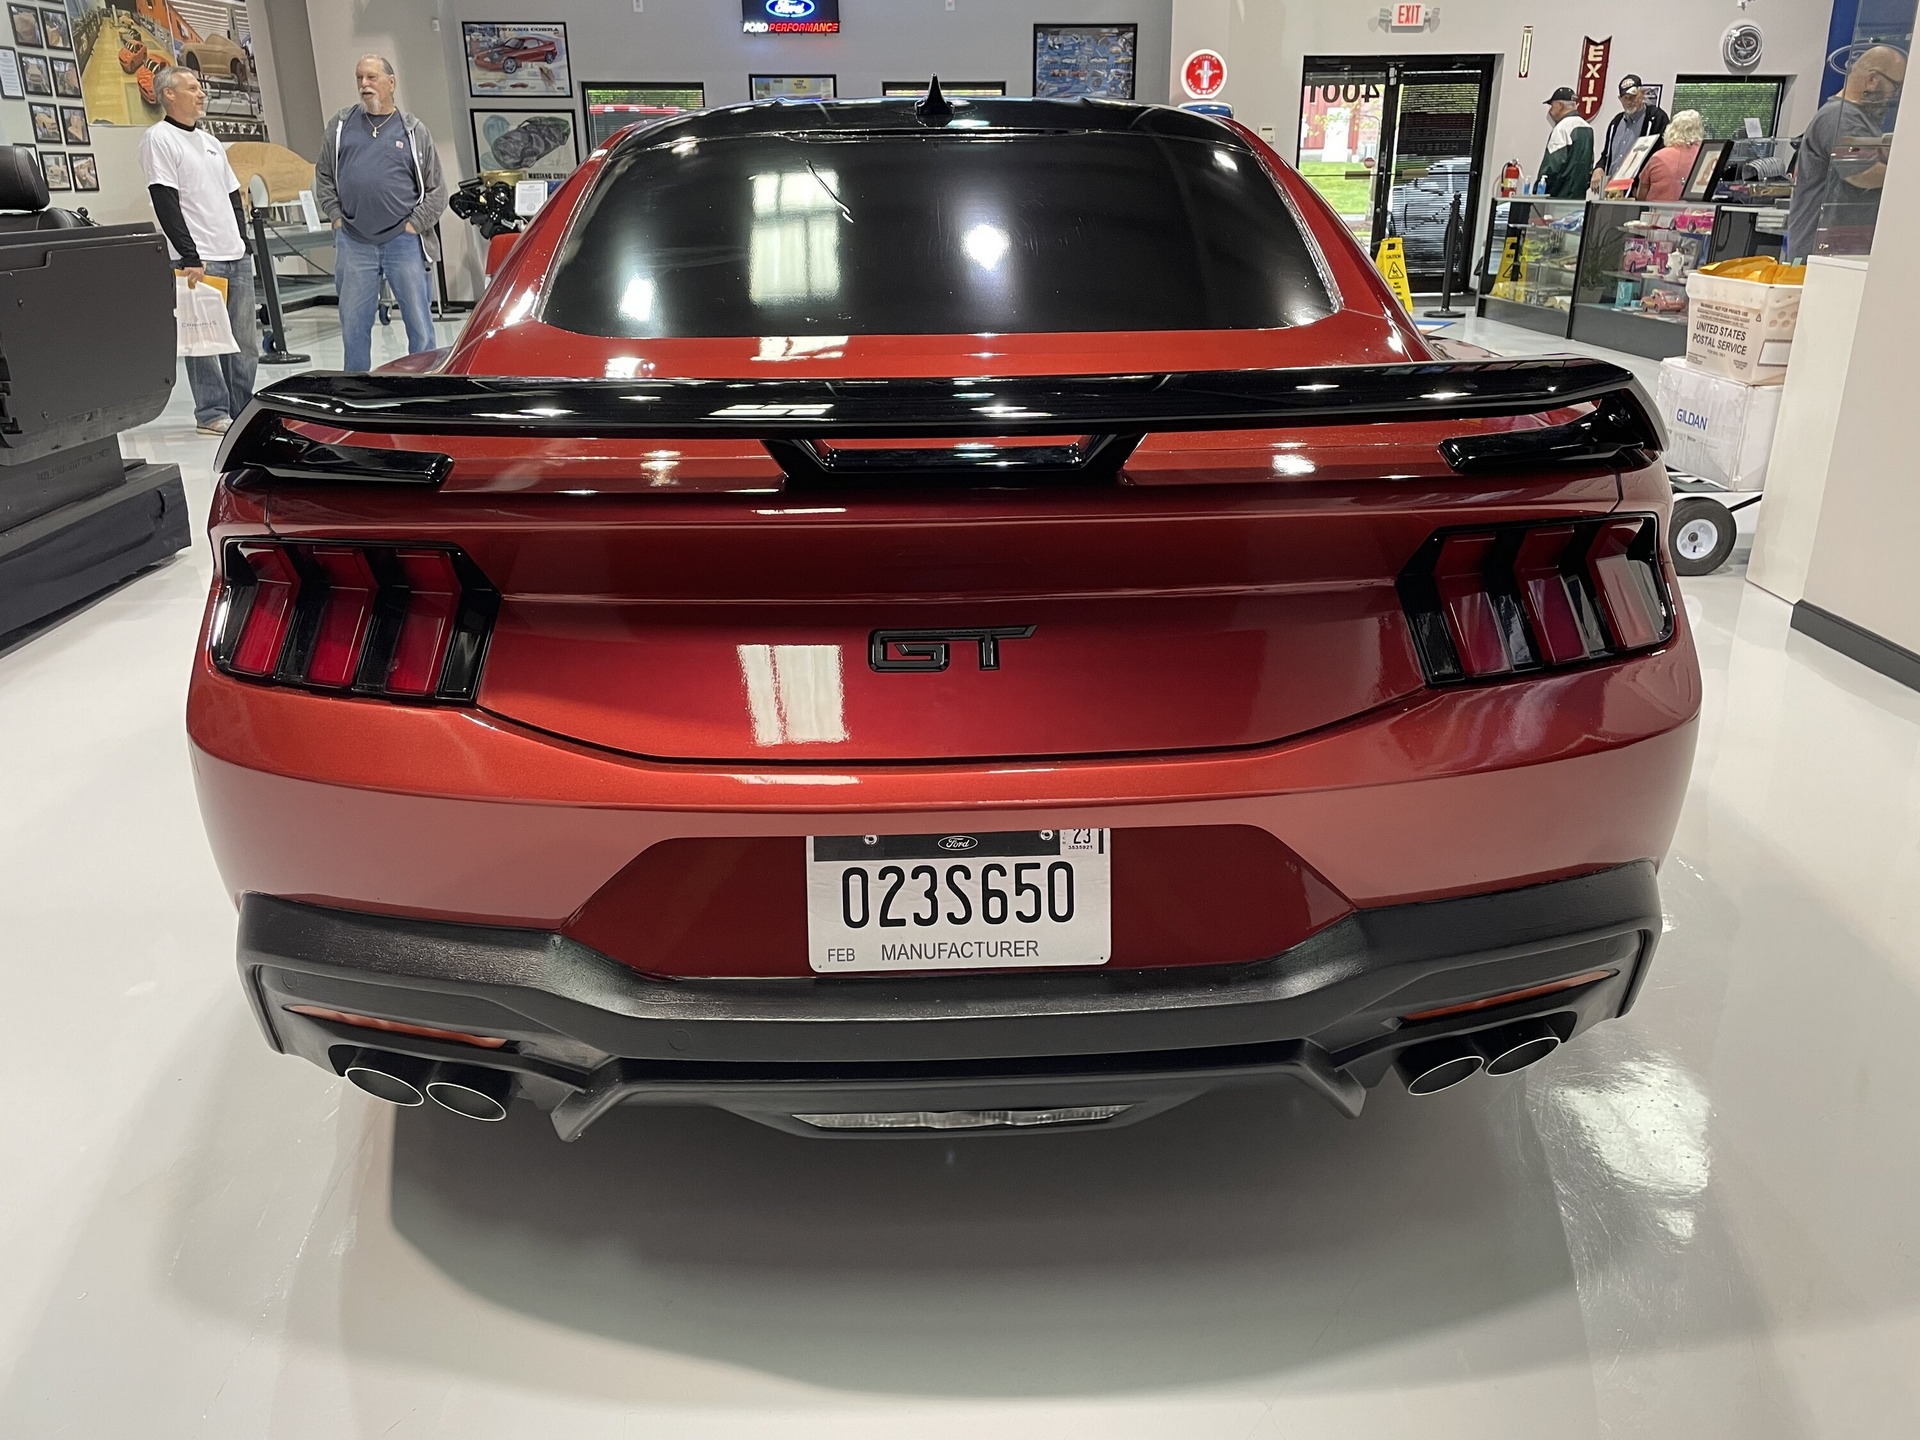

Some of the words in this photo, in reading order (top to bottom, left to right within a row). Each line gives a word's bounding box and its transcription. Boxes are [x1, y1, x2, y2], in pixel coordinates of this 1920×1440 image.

[1398, 5, 1421, 24] EXIT
[743, 22, 768, 32] FORD
[769, 23, 838, 32] PERFORMANCE
[1581, 45, 1604, 114] EXIT
[1696, 321, 1719, 335] UNITED
[1719, 327, 1746, 341] STATES
[1692, 333, 1716, 348] POSTAL
[1717, 340, 1748, 355] SERVICE
[1676, 409, 1708, 430] GILDAN
[868, 625, 1037, 672] GT
[945, 836, 970, 848] Ford
[1073, 828, 1091, 844] 23
[842, 861, 1074, 929] 023S650
[827, 948, 855, 962] FEB
[881, 940, 1039, 961] MANUFACTURER
